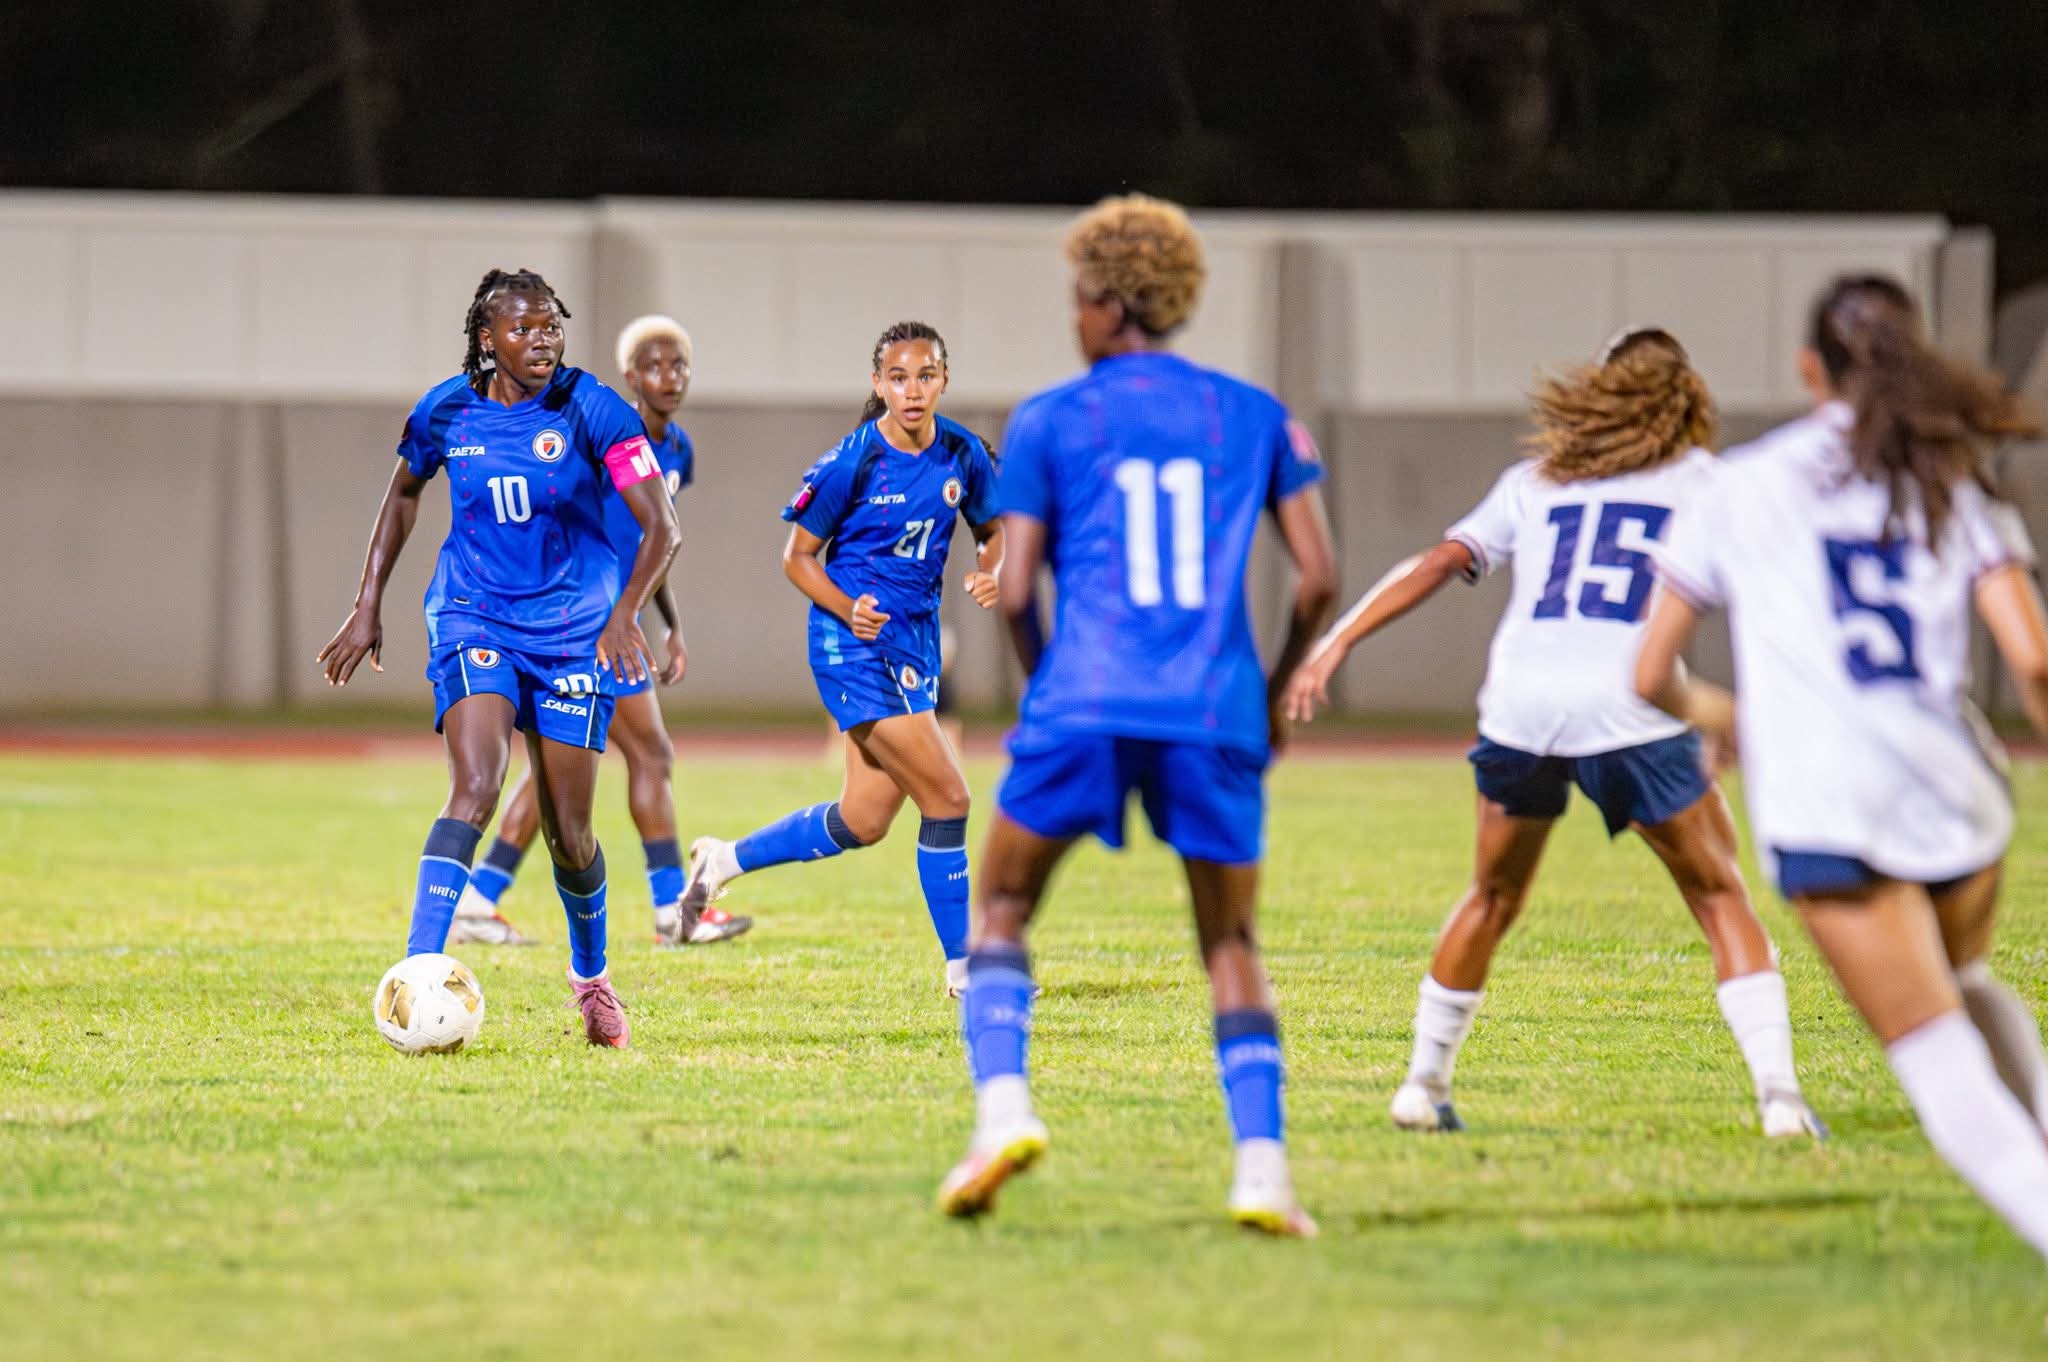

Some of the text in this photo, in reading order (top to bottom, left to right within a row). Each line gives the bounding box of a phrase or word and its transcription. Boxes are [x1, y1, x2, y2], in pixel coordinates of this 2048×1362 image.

[446, 446, 486, 457] SAETA
[487, 475, 532, 524] 10
[893, 518, 935, 560] 21
[1114, 457, 1206, 609] 11
[1532, 502, 1674, 623] 15
[1823, 535, 1922, 686] 5
[540, 699, 587, 717] SAETA
[553, 673, 593, 699] 10
